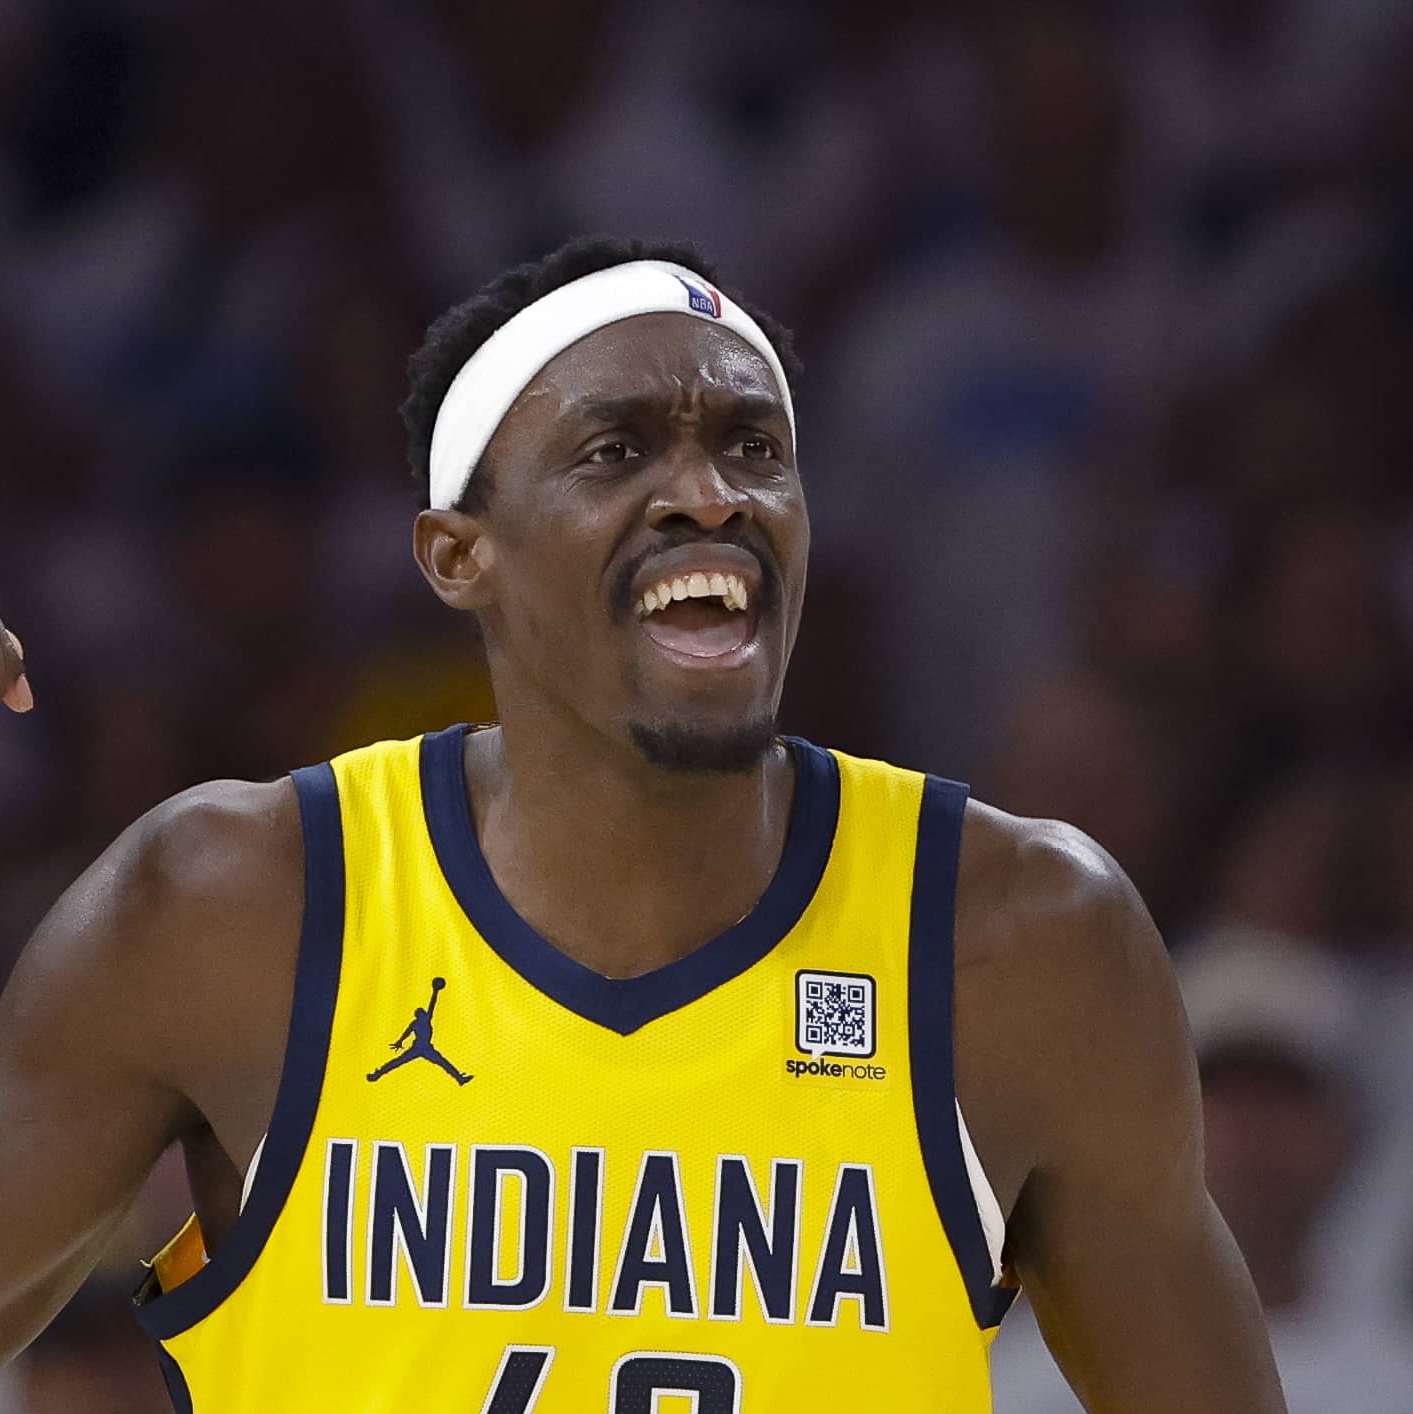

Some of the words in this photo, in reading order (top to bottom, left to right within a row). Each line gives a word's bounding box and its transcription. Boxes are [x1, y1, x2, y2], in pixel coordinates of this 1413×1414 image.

[691, 296, 714, 312] NBA
[786, 1058, 886, 1080] spokenote
[321, 1138, 890, 1332] INDIANA
